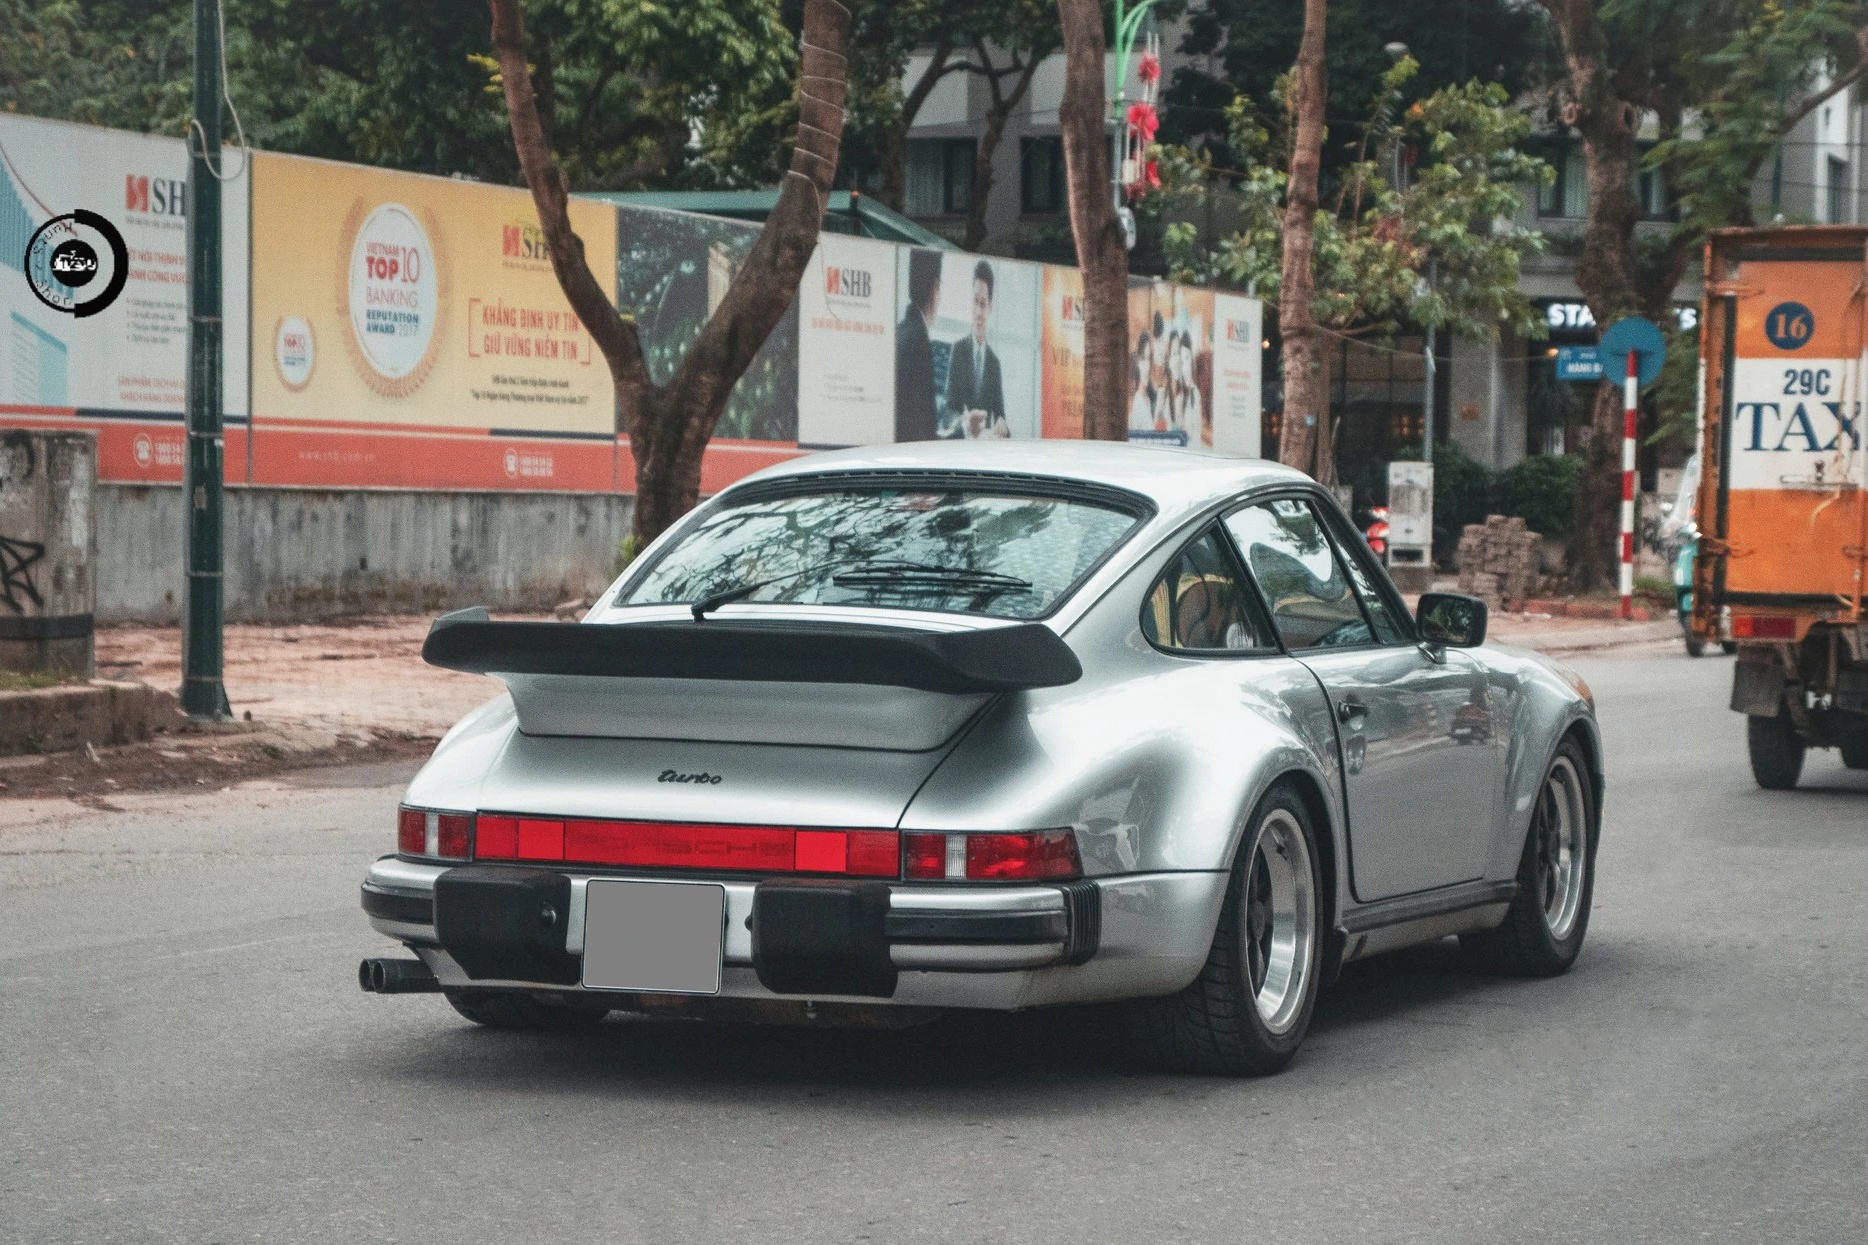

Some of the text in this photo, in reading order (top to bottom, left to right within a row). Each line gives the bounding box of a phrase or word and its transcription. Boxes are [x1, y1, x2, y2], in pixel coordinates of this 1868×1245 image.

[152, 177, 187, 216] SH
[366, 246, 421, 284] TOP 10
[841, 267, 872, 298] SHB
[366, 286, 419, 309] BANKING
[366, 309, 419, 324] REPUTATION
[366, 323, 396, 335] AWARD
[1775, 314, 1808, 340] 16
[563, 340, 578, 360] TIN
[1783, 368, 1832, 396] 29C
[1736, 402, 1868, 452] TAX
[658, 769, 722, 785] turbo
